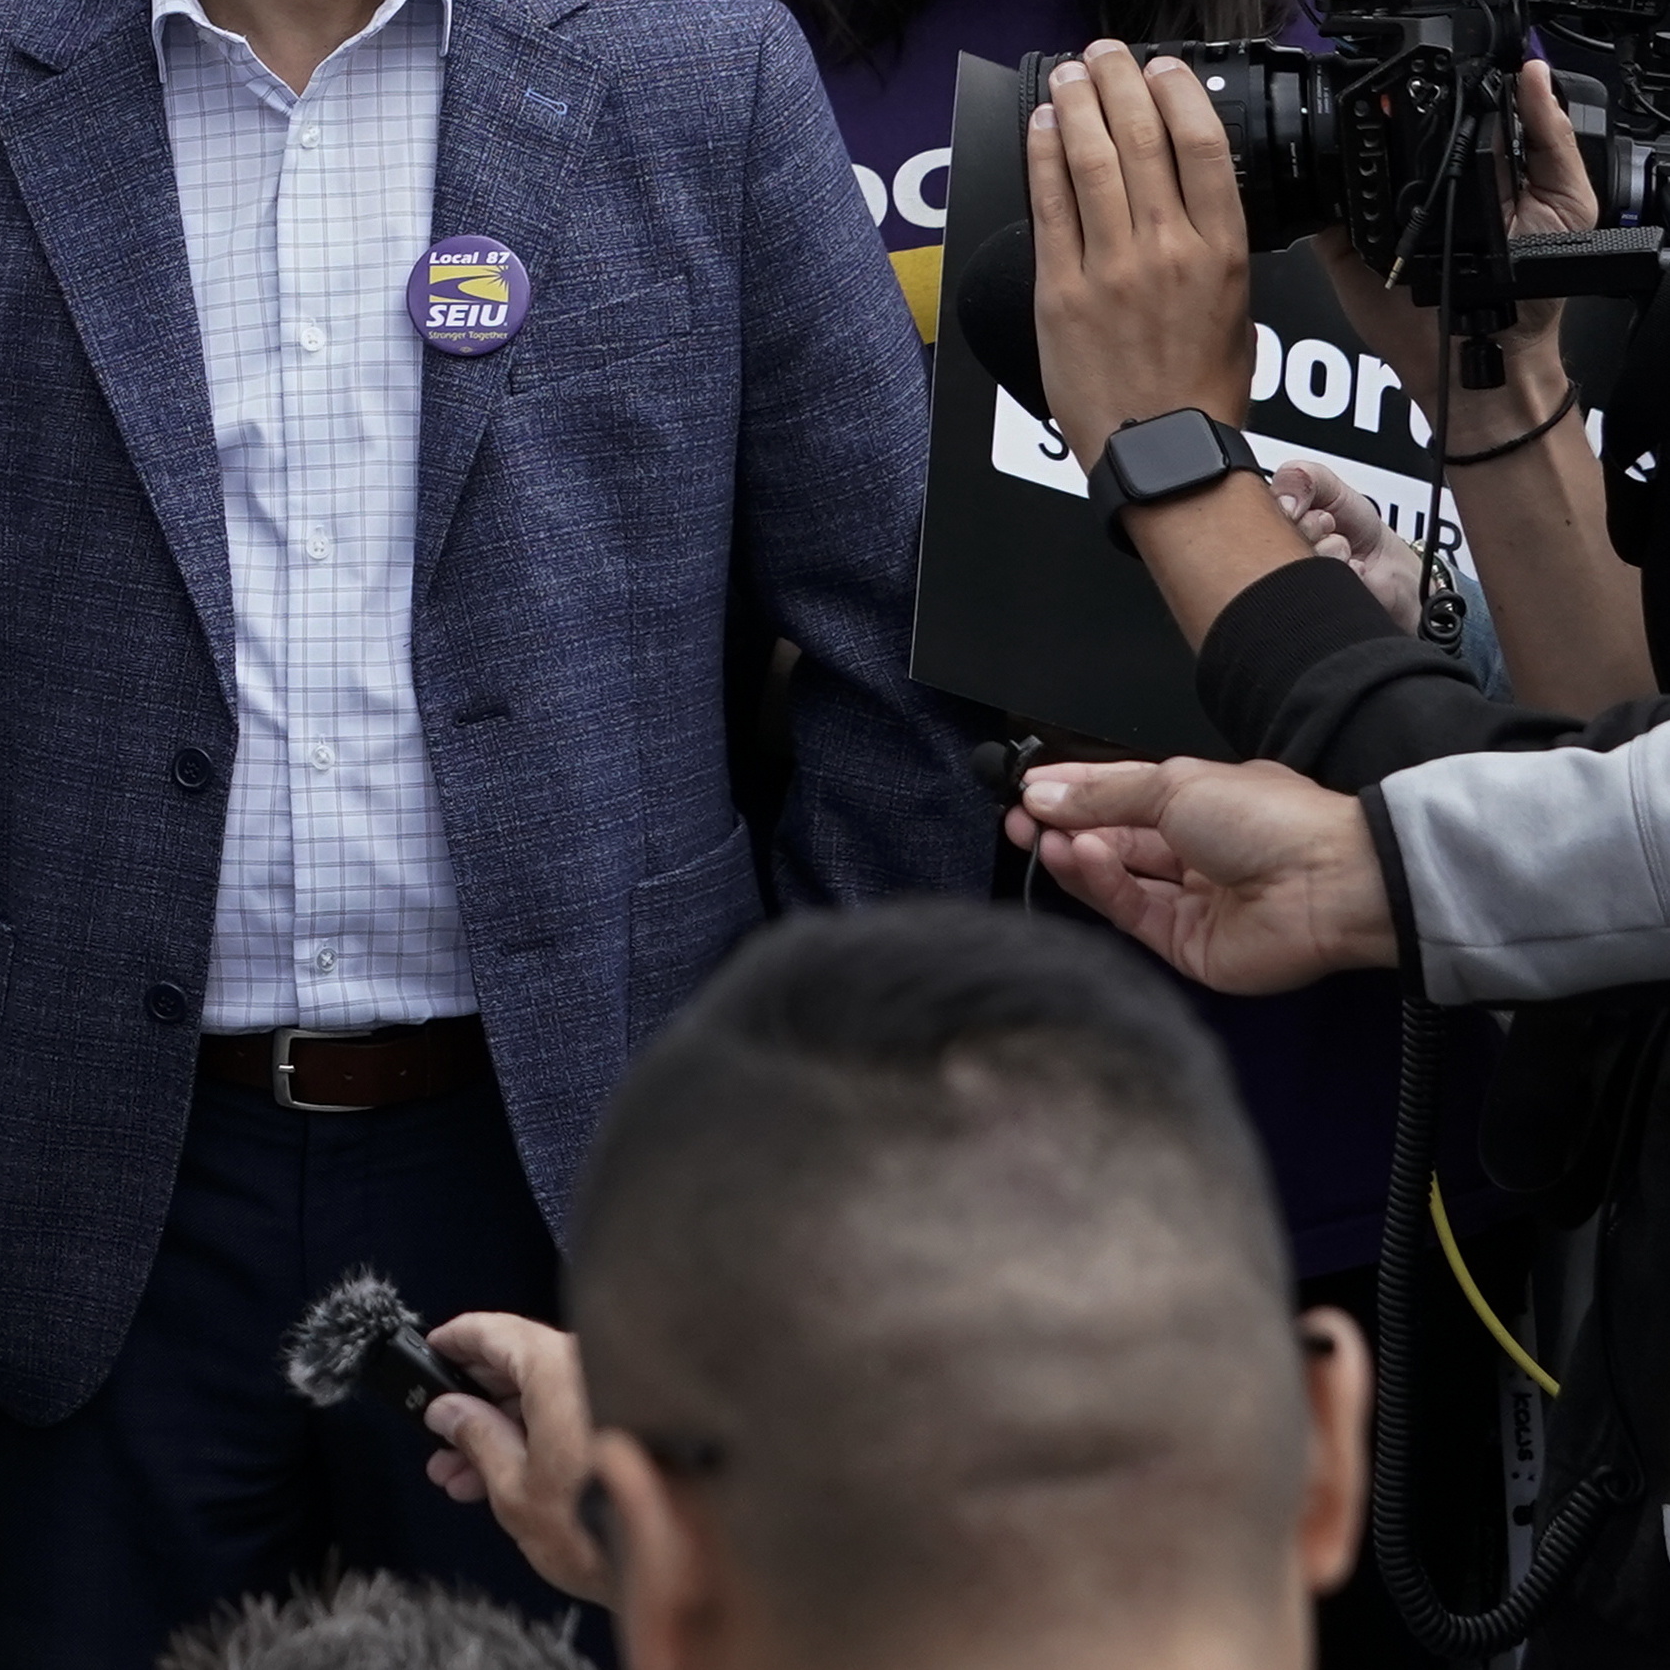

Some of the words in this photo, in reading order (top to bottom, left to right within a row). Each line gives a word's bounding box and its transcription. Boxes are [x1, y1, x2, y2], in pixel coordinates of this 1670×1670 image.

[428, 251, 479, 264] Local
[486, 251, 510, 264] 87
[425, 304, 508, 328] SEIU
[428, 330, 466, 341] Stronger
[469, 330, 508, 341] Together
